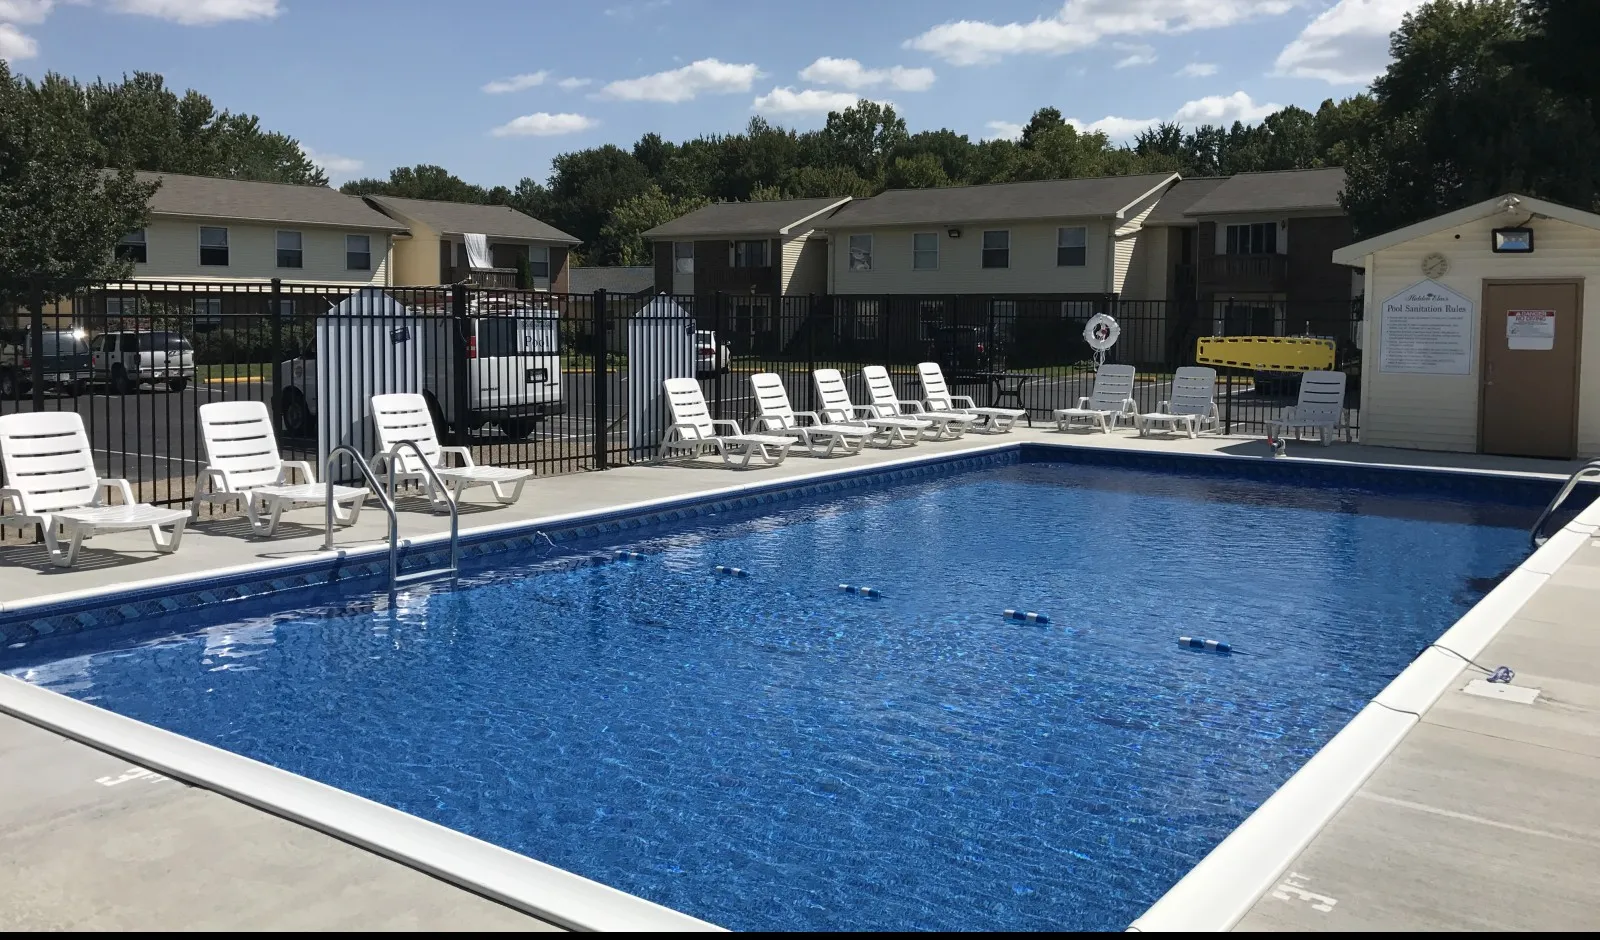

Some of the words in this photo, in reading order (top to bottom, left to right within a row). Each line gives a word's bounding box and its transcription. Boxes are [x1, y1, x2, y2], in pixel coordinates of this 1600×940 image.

[1387, 304, 1403, 313] Pool
[1405, 304, 1442, 313] Sanitation
[1445, 304, 1466, 313] Rules
